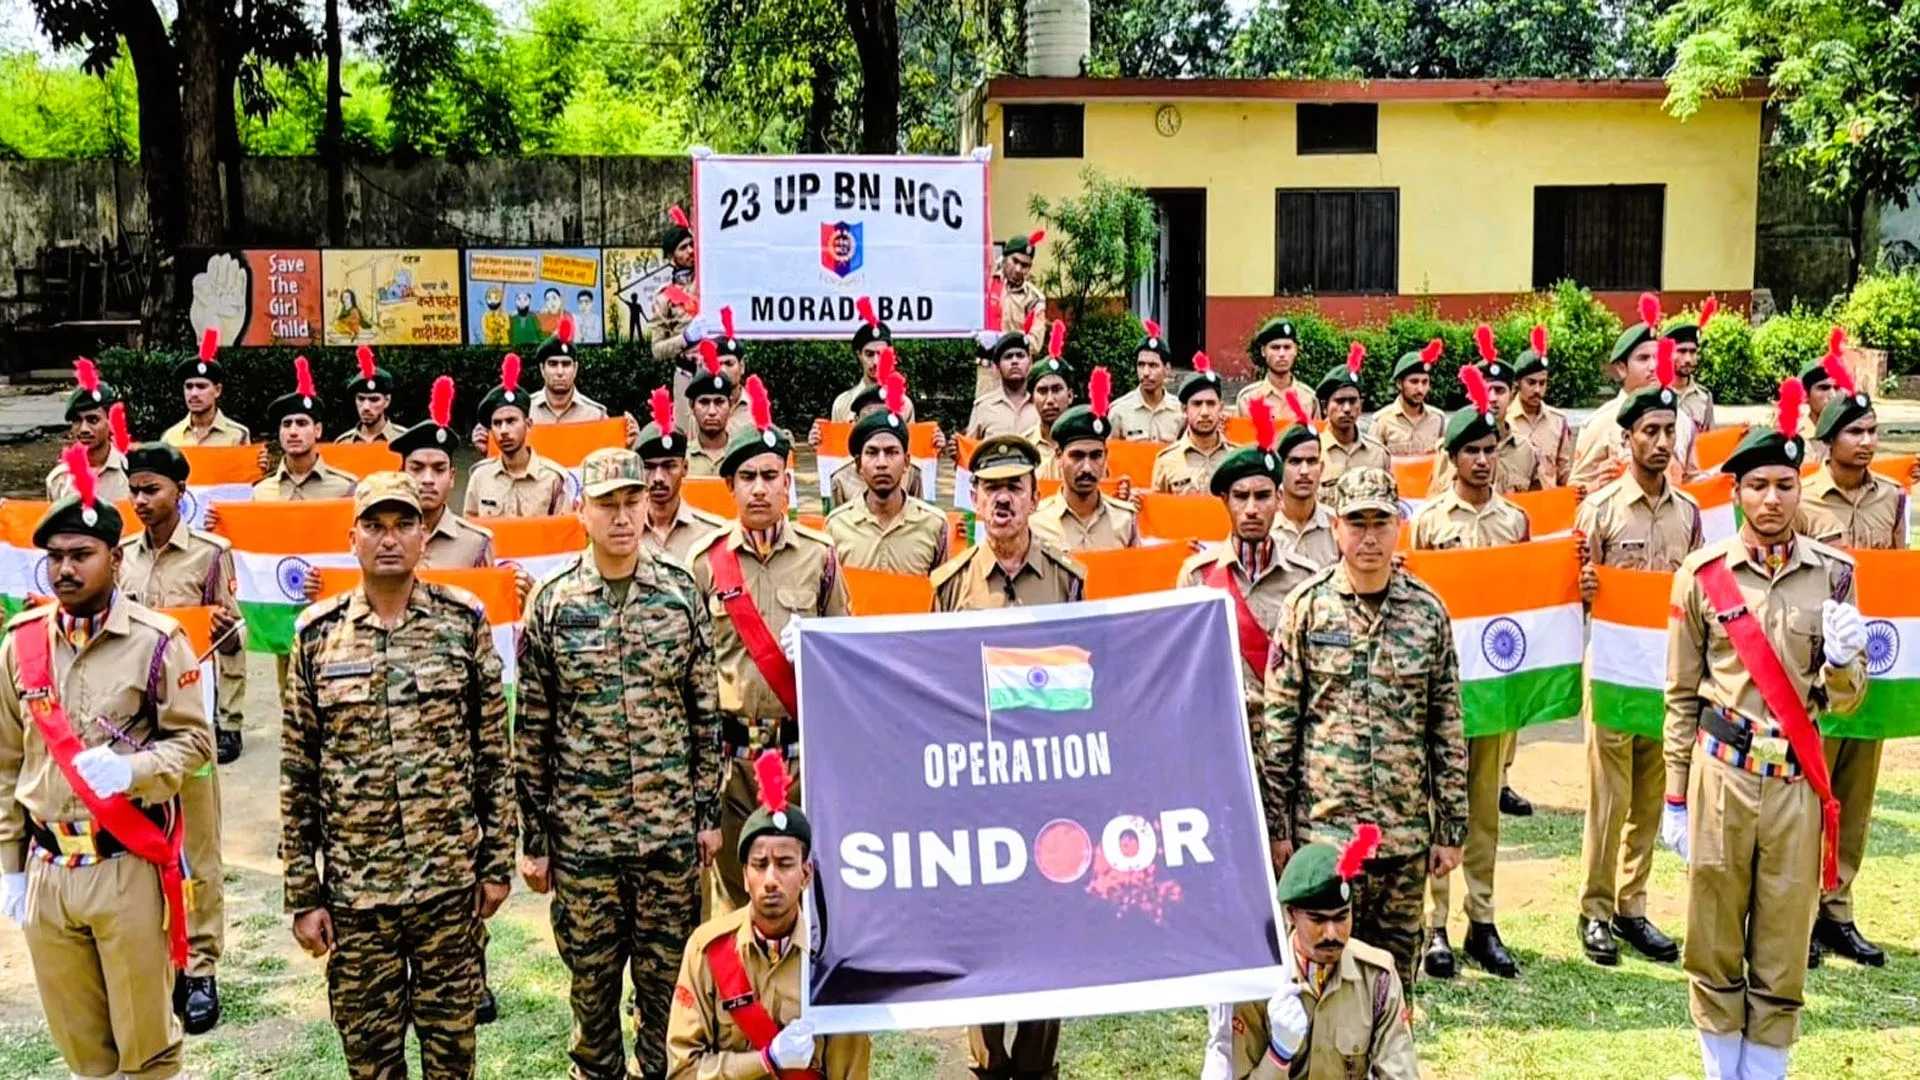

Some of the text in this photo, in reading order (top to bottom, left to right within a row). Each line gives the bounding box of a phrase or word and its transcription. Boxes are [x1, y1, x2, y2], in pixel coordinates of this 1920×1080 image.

[720, 172, 963, 231] 23 UP BN NCC
[268, 253, 306, 274] Save
[268, 276, 299, 294] The
[269, 298, 299, 317] Girl
[751, 295, 934, 323] MORADBAD
[270, 319, 310, 338] Child
[923, 731, 1112, 789] OPERATION
[839, 806, 1215, 891] SINDOOR
